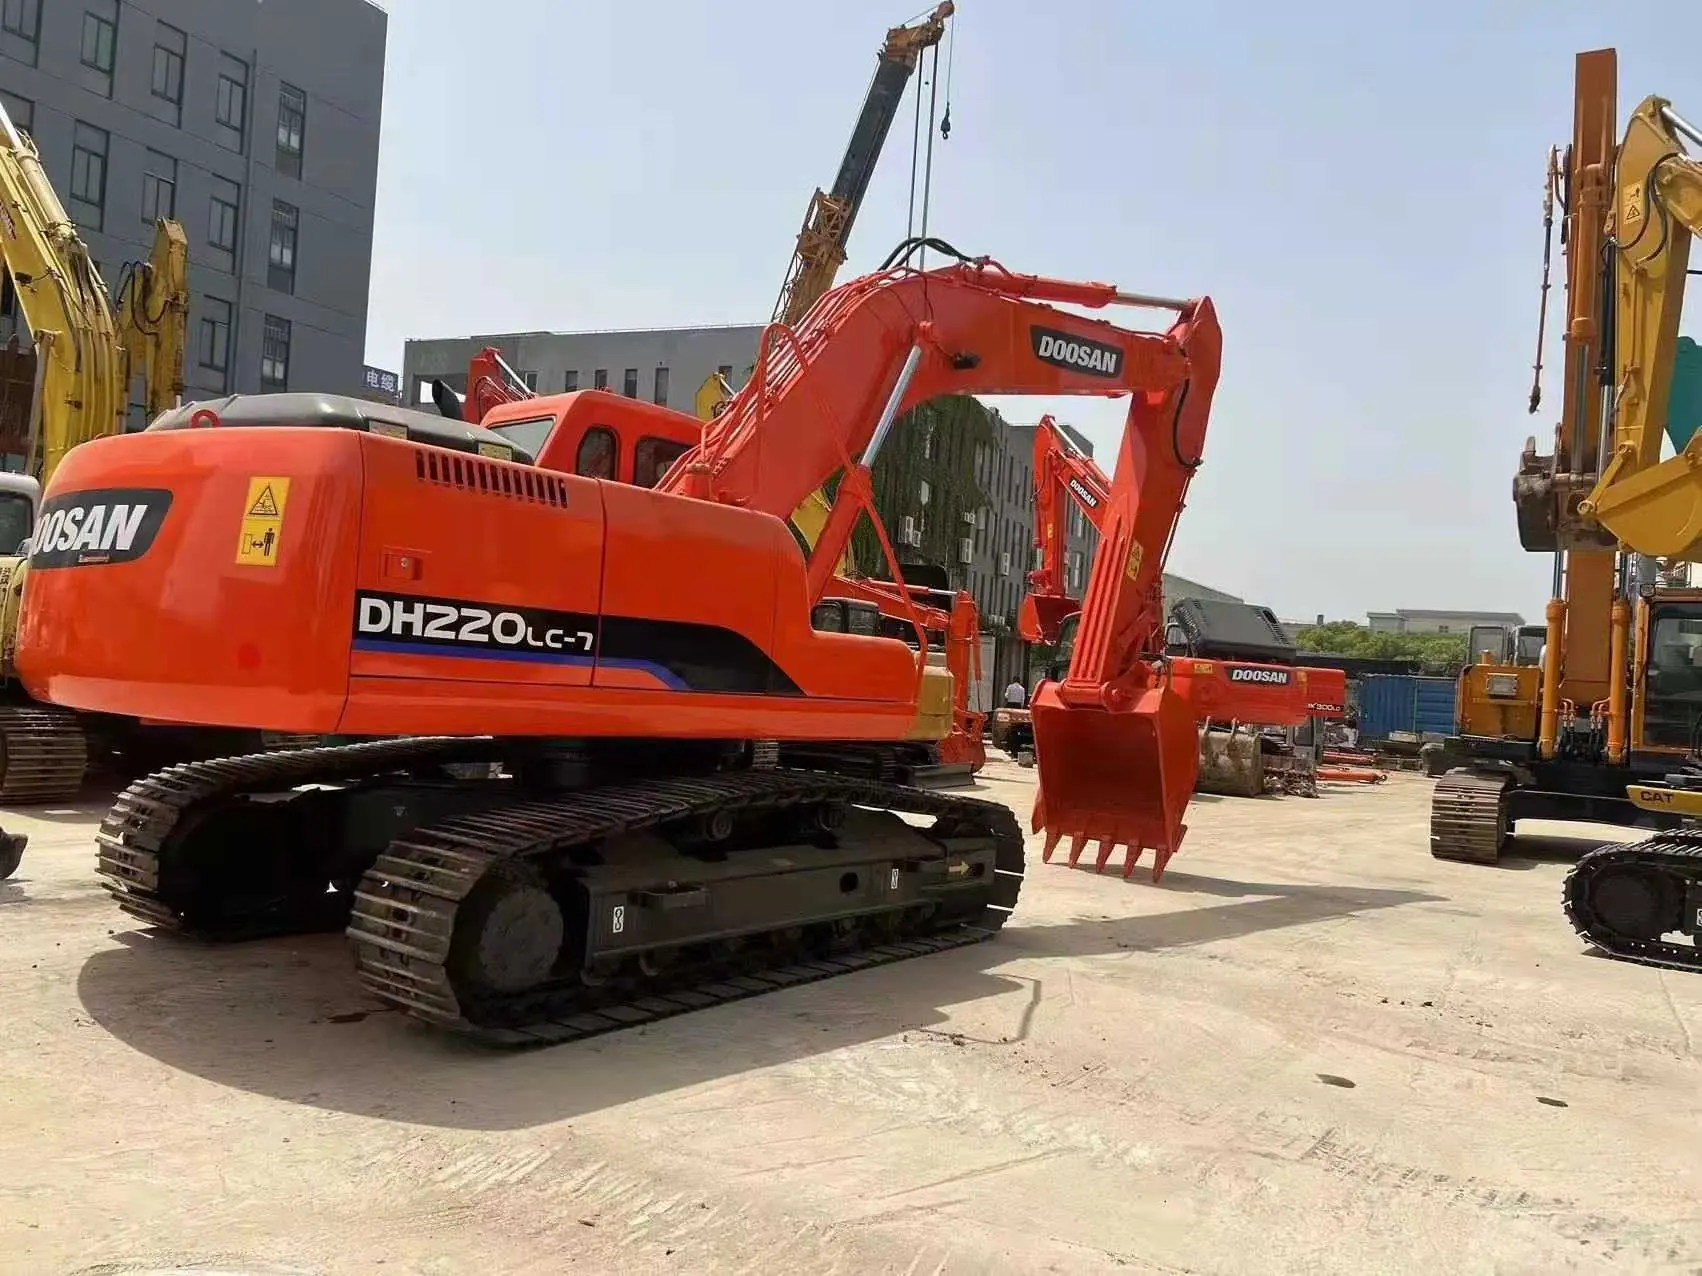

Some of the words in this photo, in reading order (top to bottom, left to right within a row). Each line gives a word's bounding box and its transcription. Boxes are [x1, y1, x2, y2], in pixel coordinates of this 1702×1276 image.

[1038, 335, 1117, 374] DOOSAN
[1070, 479, 1097, 507] DOOSAN
[31, 504, 148, 555] OOSAN
[1231, 669, 1288, 684] DOOSAN
[1640, 790, 1675, 803] CAT
